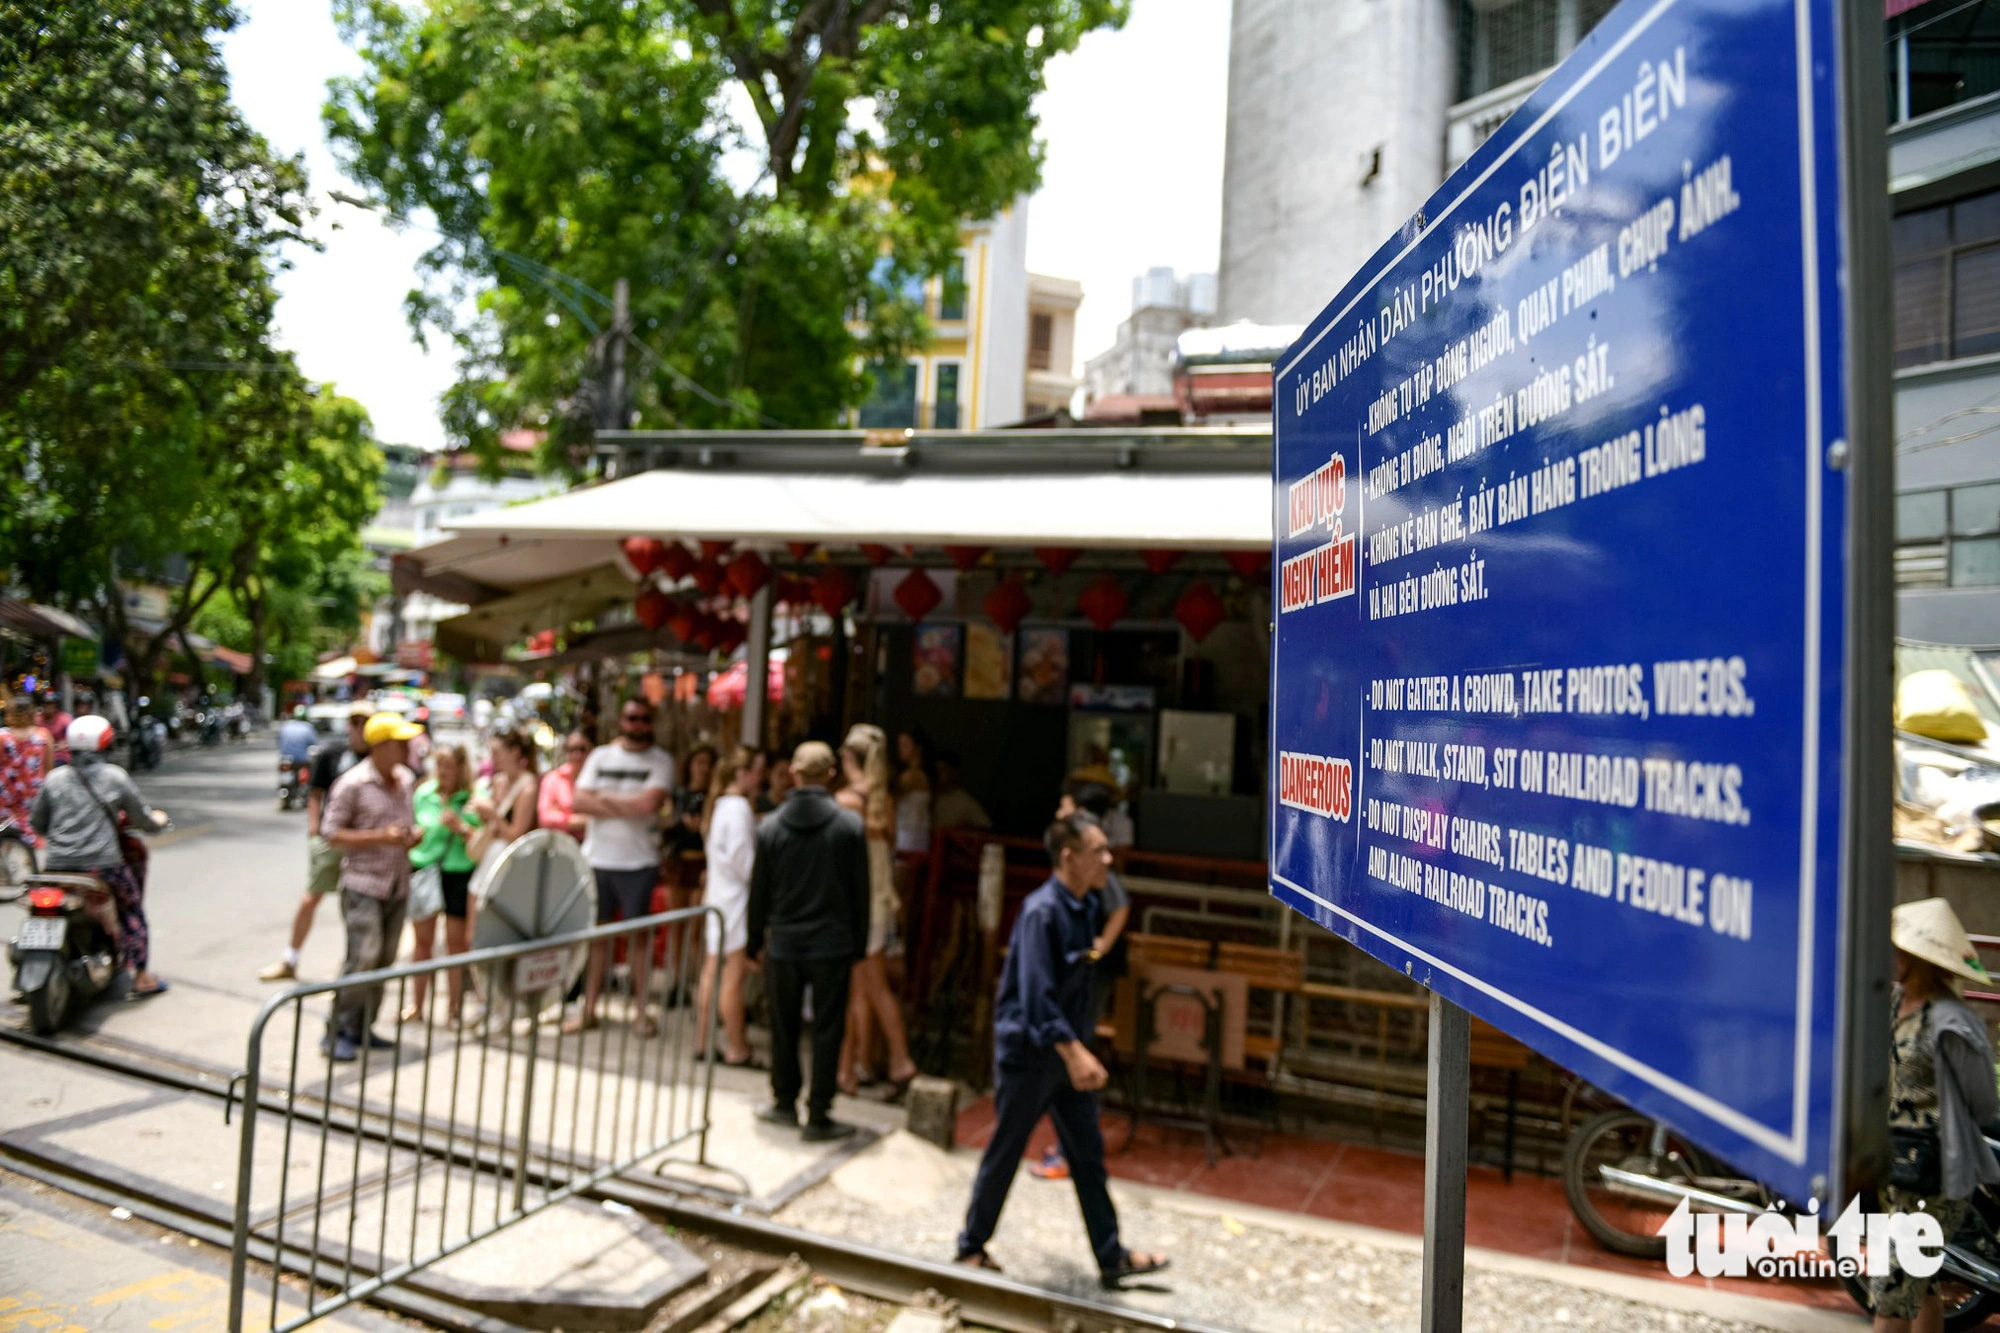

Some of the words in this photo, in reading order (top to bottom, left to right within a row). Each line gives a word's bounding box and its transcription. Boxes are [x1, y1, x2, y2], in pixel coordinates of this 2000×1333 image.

[1296, 374, 1310, 416] ỦY
[1313, 355, 1336, 403] BAN
[1340, 319, 1376, 381] NHÂN
[1381, 286, 1415, 346] DÂN
[1421, 202, 1512, 313] PHƯỜNG
[1520, 132, 1588, 233] ĐIỆN
[1599, 46, 1687, 170] BIÊN
[1369, 388, 1398, 436] KHÔNG
[1400, 374, 1412, 420] TỤ
[1414, 361, 1434, 412] TẬP
[1436, 340, 1467, 394] ĐÔNG
[1470, 304, 1515, 373] NGƯỜI,
[1518, 277, 1559, 345] QUAY
[1562, 242, 1615, 316] PHIM,
[1618, 197, 1675, 279] CHỤP
[1679, 155, 1740, 242] ẢNH.
[1369, 456, 1399, 501] KHÔNG
[1400, 449, 1411, 486] ĐI
[1413, 431, 1445, 480] ĐỨNG,
[1447, 403, 1477, 465] NGỒI
[1479, 392, 1515, 449] TRÊN
[1517, 364, 1571, 432] ĐƯỜNG
[1575, 333, 1614, 404] SẮT.
[1289, 472, 1316, 538] KHU
[1316, 452, 1345, 532] VỰC
[1370, 524, 1399, 566] KHÔNG
[1401, 512, 1414, 556] KÊ
[1417, 505, 1438, 551] BÀN
[1441, 485, 1466, 543] GHẾ,
[1469, 477, 1495, 534] BẦY
[1498, 471, 1528, 526] BÁN
[1531, 457, 1575, 515] HÀNG
[1578, 429, 1641, 499] TRONG
[1645, 403, 1706, 478] LÒNG
[1281, 549, 1316, 613] NGUY
[1317, 519, 1355, 604] HIỂM
[1369, 581, 1380, 621] VÀ
[1382, 583, 1397, 618] HAI
[1399, 572, 1418, 615] BÊN
[1420, 562, 1458, 611] ĐƯỜNG
[1461, 548, 1488, 603] SẮT.
[1371, 679, 1384, 711] DO
[1386, 678, 1404, 711] NOT
[1407, 676, 1448, 711] GATHER
[1451, 675, 1460, 711] A
[1464, 673, 1519, 718] CROWD,
[1522, 669, 1563, 713] TAKE
[1566, 663, 1649, 721] PHOTOS,
[1653, 655, 1755, 718] VIDEOS.
[1280, 752, 1352, 822] DANGEROUS
[1371, 738, 1383, 770] DO
[1385, 739, 1404, 773] NOT
[1407, 741, 1440, 783] WALK,
[1443, 744, 1489, 790] STAND,
[1493, 747, 1517, 789] SIT
[1520, 749, 1543, 793] ON
[1546, 751, 1639, 808] RAILROAD
[1643, 758, 1751, 827] TRACKS.
[1368, 798, 1380, 831] DO
[1382, 802, 1401, 837] NOT
[1403, 806, 1449, 850] DISPLAY
[1451, 816, 1505, 872] CHAIRS,
[1509, 828, 1569, 885] TABLES
[1571, 843, 1613, 898] AND
[1616, 852, 1705, 926] PEDDLE
[1709, 873, 1752, 941] ON
[1368, 845, 1387, 881] AND
[1389, 852, 1422, 895] ALONG
[1424, 863, 1484, 920] RAILROAD
[1488, 884, 1553, 948] TRACKS.
